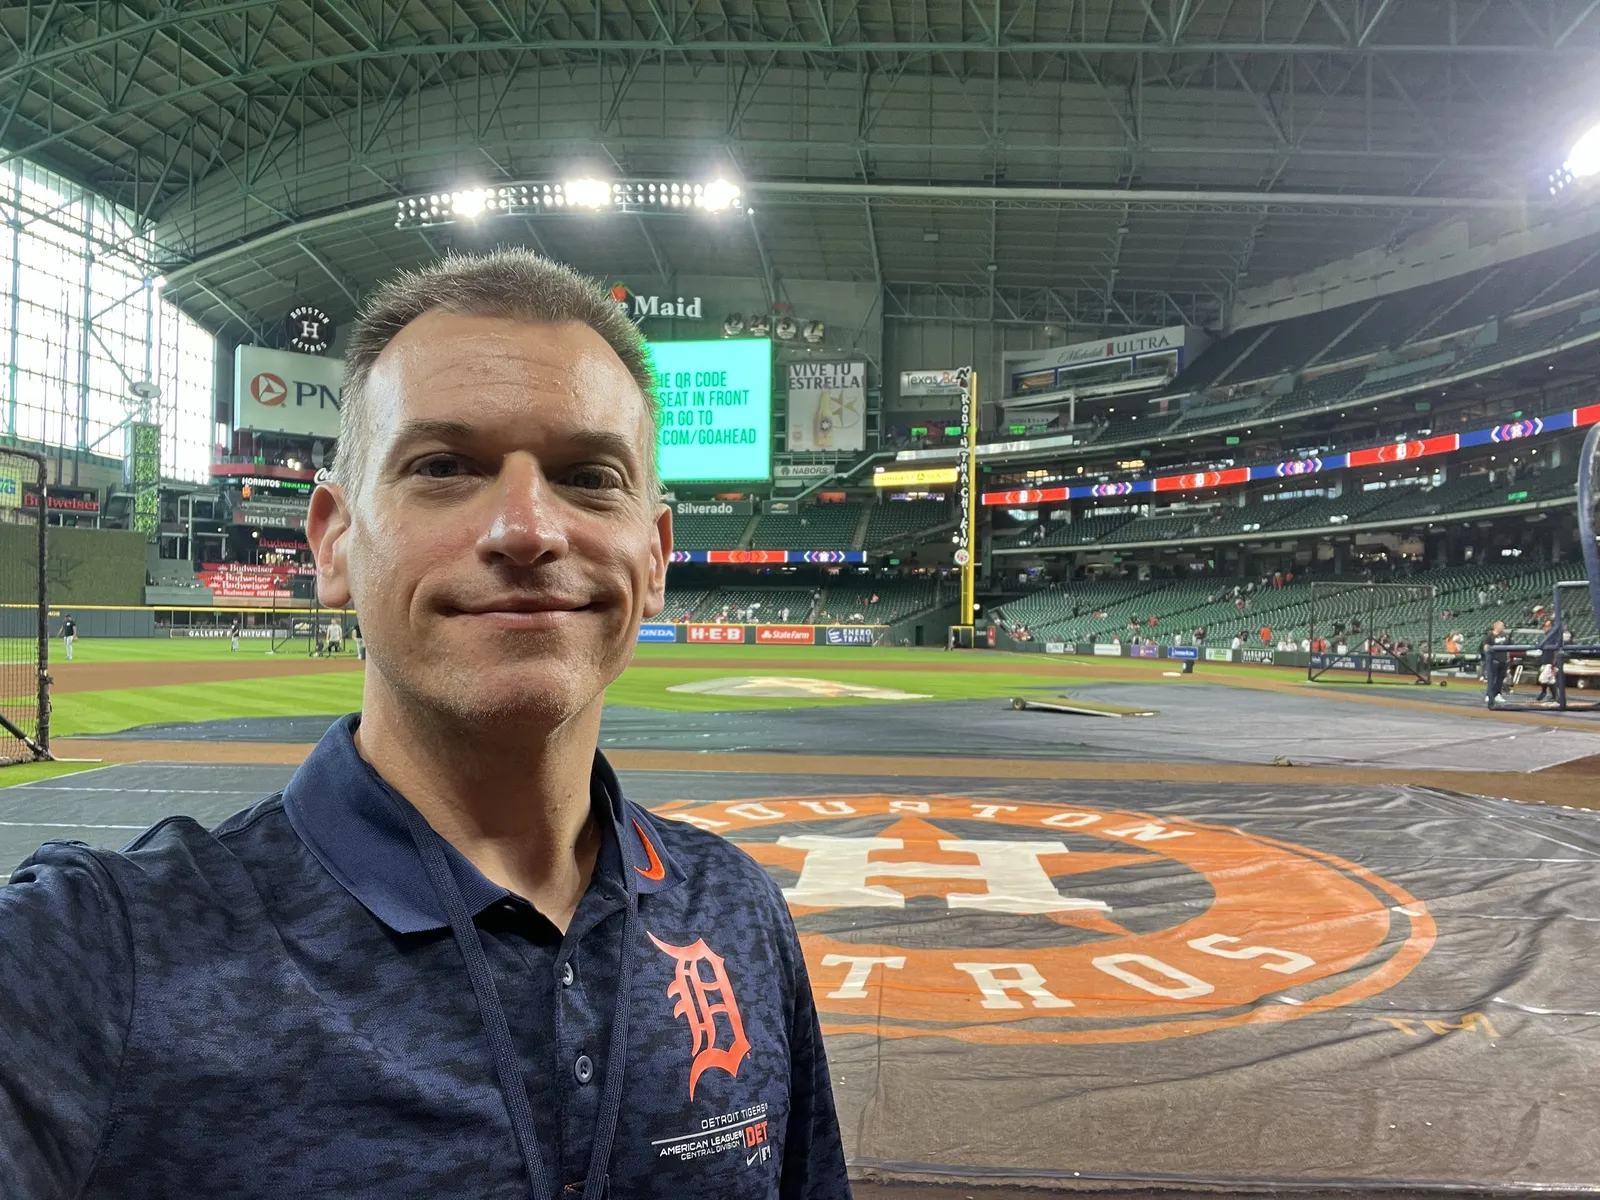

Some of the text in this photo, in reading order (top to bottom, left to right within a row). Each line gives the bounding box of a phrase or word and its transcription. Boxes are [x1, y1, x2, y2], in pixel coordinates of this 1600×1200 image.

[289, 306, 330, 325] HOUSTON
[634, 296, 702, 318] Maid
[301, 320, 320, 340] H
[291, 337, 328, 352] ASTROS
[1117, 335, 1170, 354] ULTRA
[832, 362, 851, 376] TU
[675, 372, 691, 388] QR
[695, 371, 727, 388] CODE
[905, 372, 938, 387] Texas
[292, 380, 342, 412] PN
[660, 390, 749, 407] SEAT IN FRONT
[677, 410, 693, 426] GO
[698, 409, 713, 425] TO
[961, 394, 970, 434] ROOT
[792, 467, 828, 475] NABORS
[960, 452, 969, 483] THA
[241, 477, 280, 488] HORNITOS
[677, 503, 733, 514] Silverado
[244, 514, 286, 526] impact
[960, 487, 969, 548] CHIKIN
[225, 572, 271, 582] Budweiser
[230, 564, 273, 573] Budweiser
[222, 581, 269, 589] Budweiser
[188, 629, 271, 637] GALLERY FNITURE
[638, 629, 674, 637] ONDA
[843, 635, 871, 643] TRANS
[777, 835, 1113, 913] H
[821, 932, 1316, 1009] TROS
[647, 930, 752, 1103] D
[1372, 1012, 1501, 1038] TM
[701, 1111, 739, 1130] DETROIT
[745, 1120, 768, 1148] DET
[659, 1139, 709, 1157] AMERICAN
[681, 1140, 741, 1161] CENTRAL DIVISION
